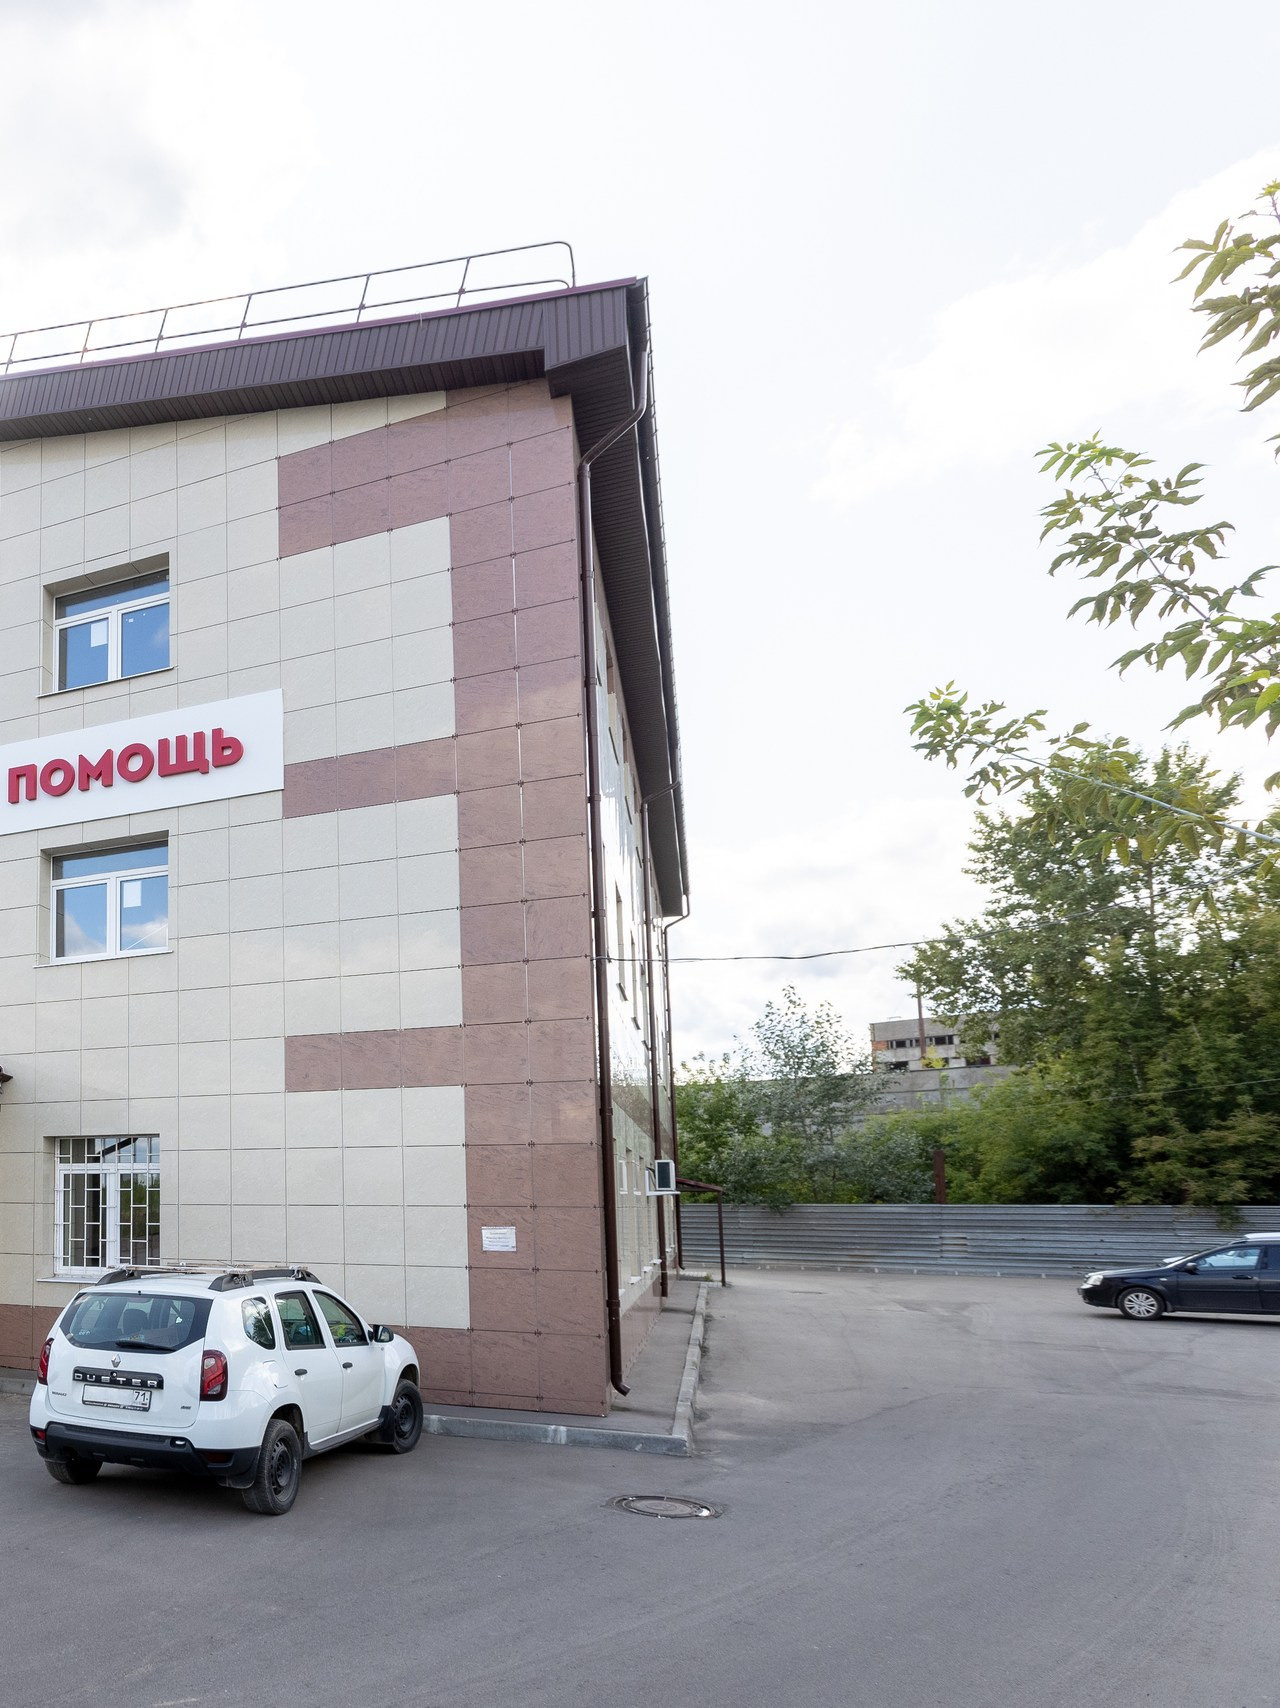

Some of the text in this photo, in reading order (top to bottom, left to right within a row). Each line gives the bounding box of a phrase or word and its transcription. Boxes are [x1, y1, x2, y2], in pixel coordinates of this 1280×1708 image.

[8, 728, 244, 804] ПОМОЩЬ
[74, 1373, 158, 1387] DUSTER
[134, 1391, 146, 1402] 71
